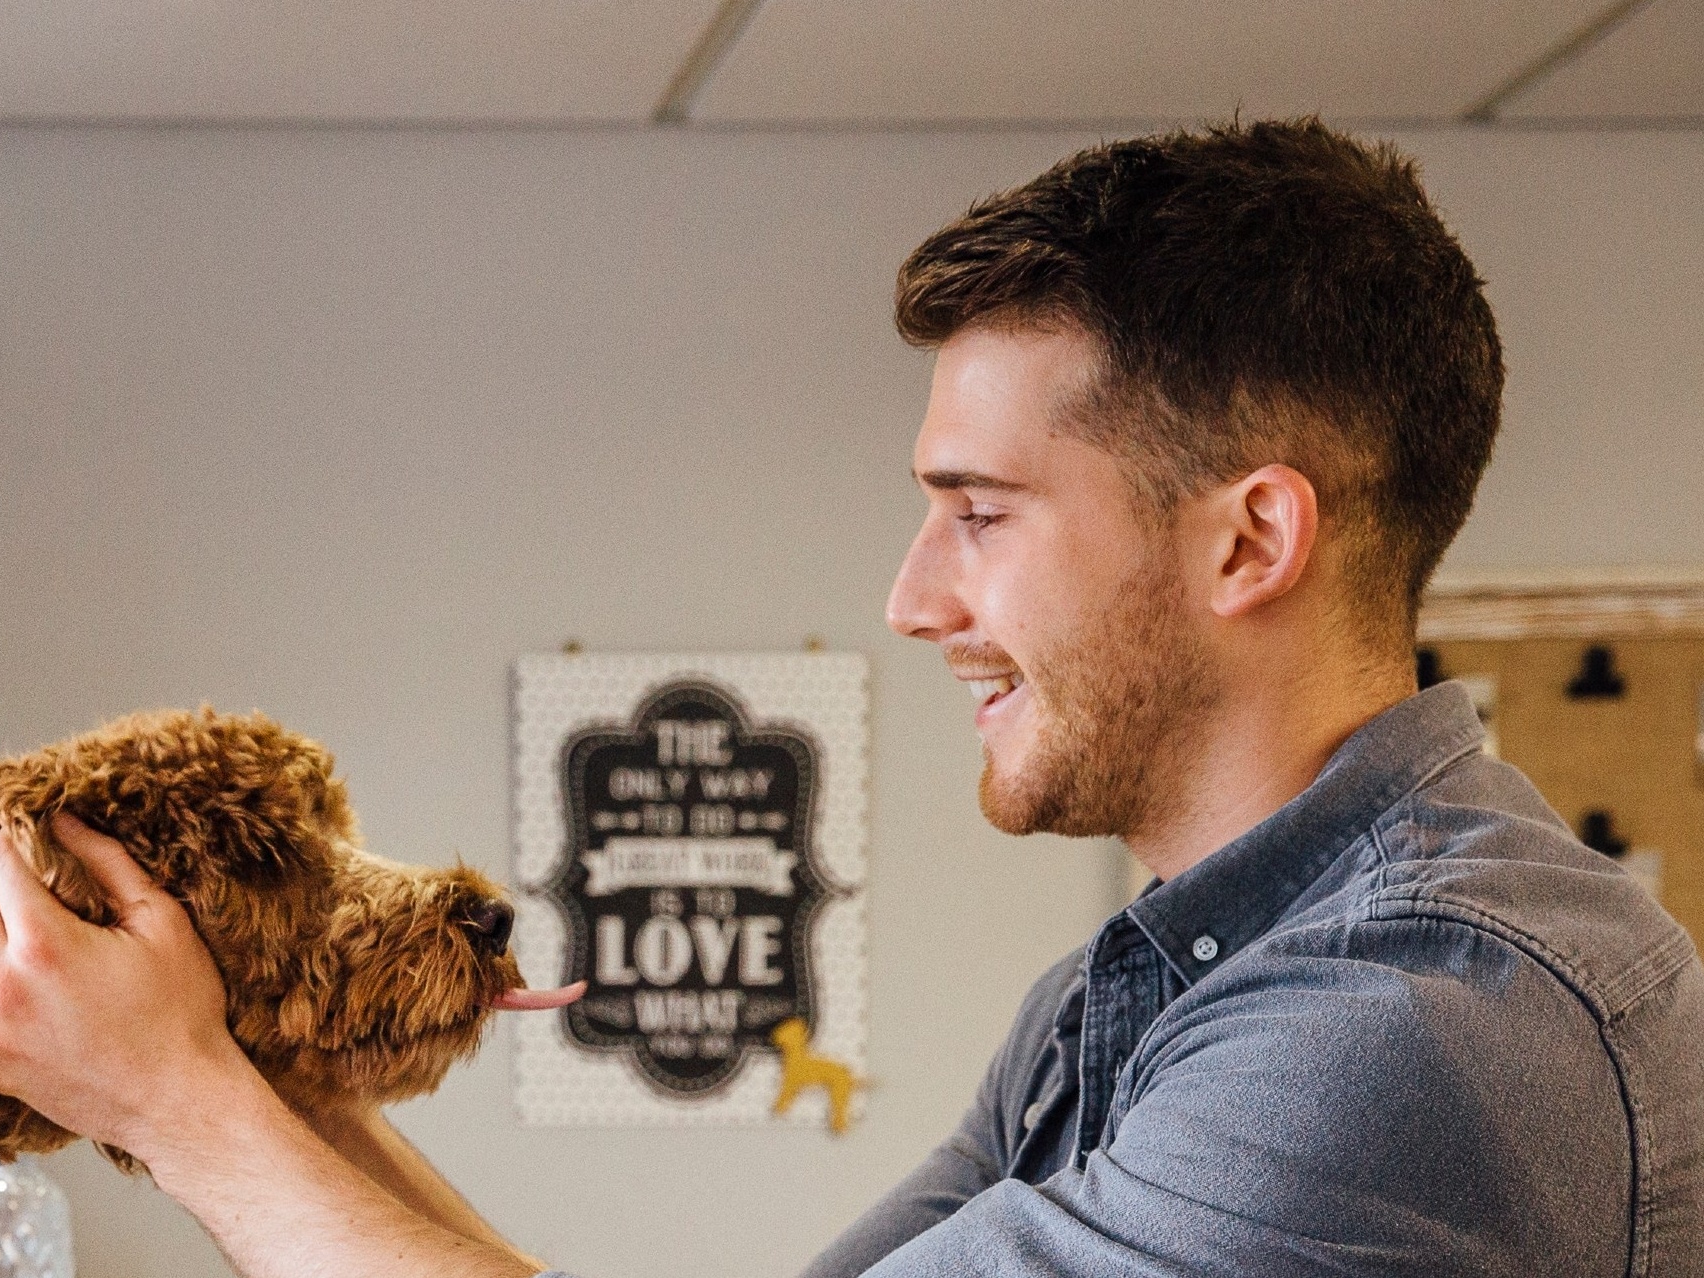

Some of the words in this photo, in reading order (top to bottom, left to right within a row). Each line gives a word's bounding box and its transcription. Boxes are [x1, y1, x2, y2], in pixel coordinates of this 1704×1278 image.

[653, 719, 734, 766] THE
[608, 767, 689, 800] ONLY
[596, 914, 785, 985] LOVE
[634, 990, 746, 1034] WHAT
